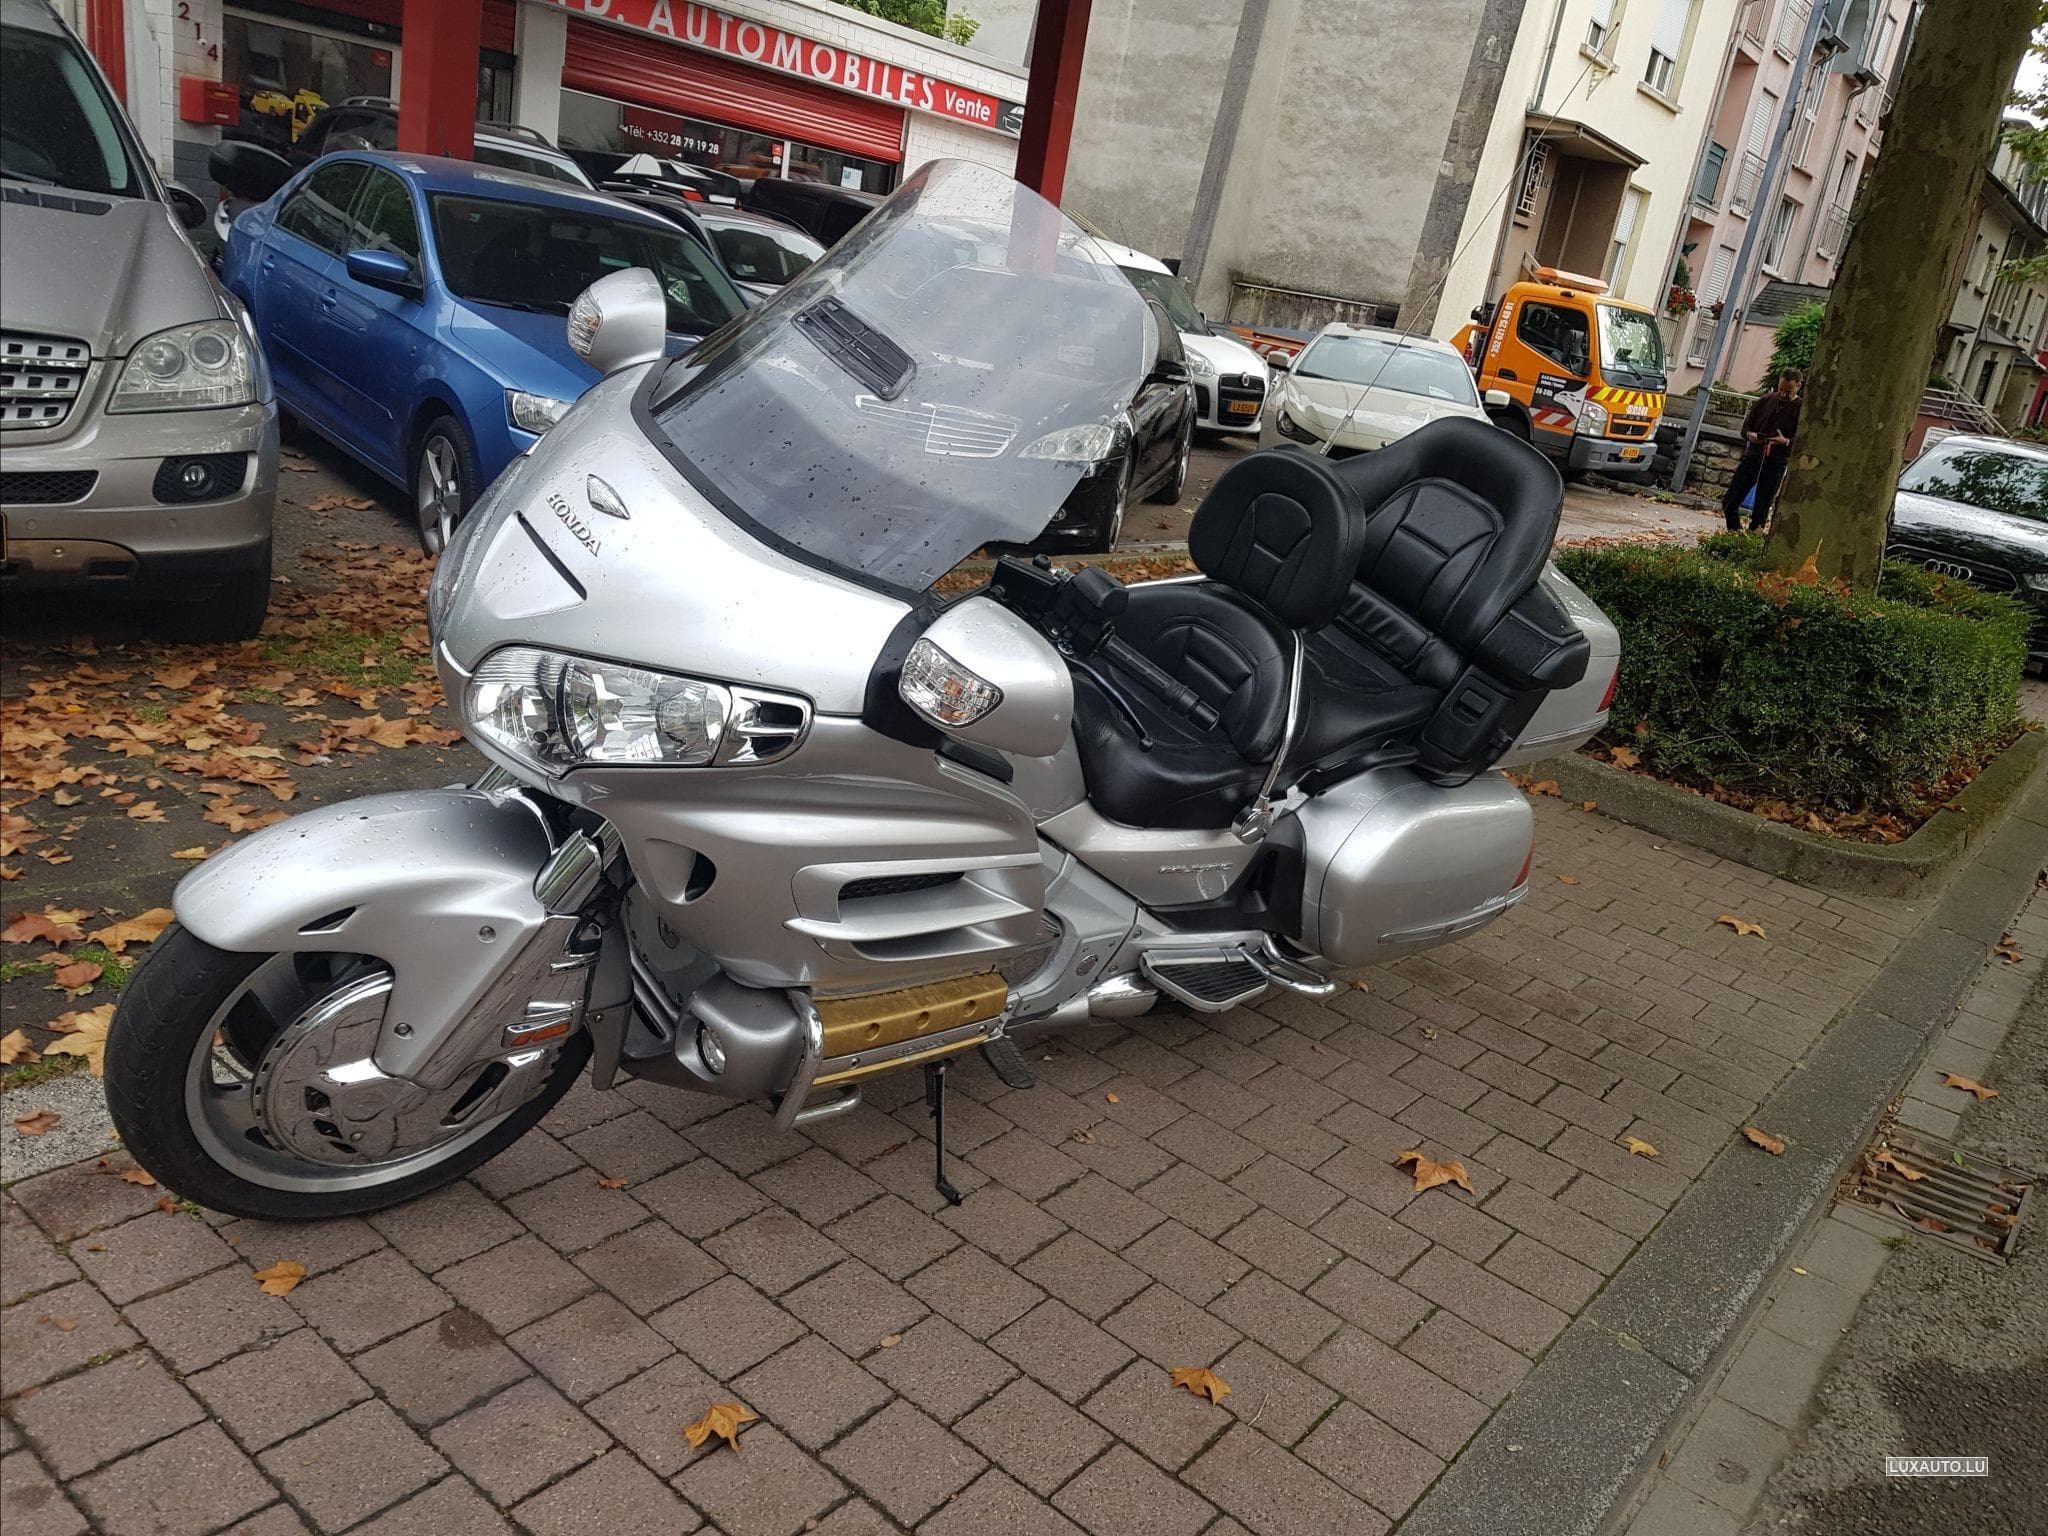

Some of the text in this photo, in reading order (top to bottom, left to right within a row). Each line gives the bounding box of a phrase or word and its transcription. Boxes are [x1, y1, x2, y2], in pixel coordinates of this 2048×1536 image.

[647, 0, 936, 111] AUTOMOBILES
[945, 88, 991, 122] Vente
[628, 124, 719, 154] Tél: +352 28 79 19 28
[546, 490, 602, 557] HONDA
